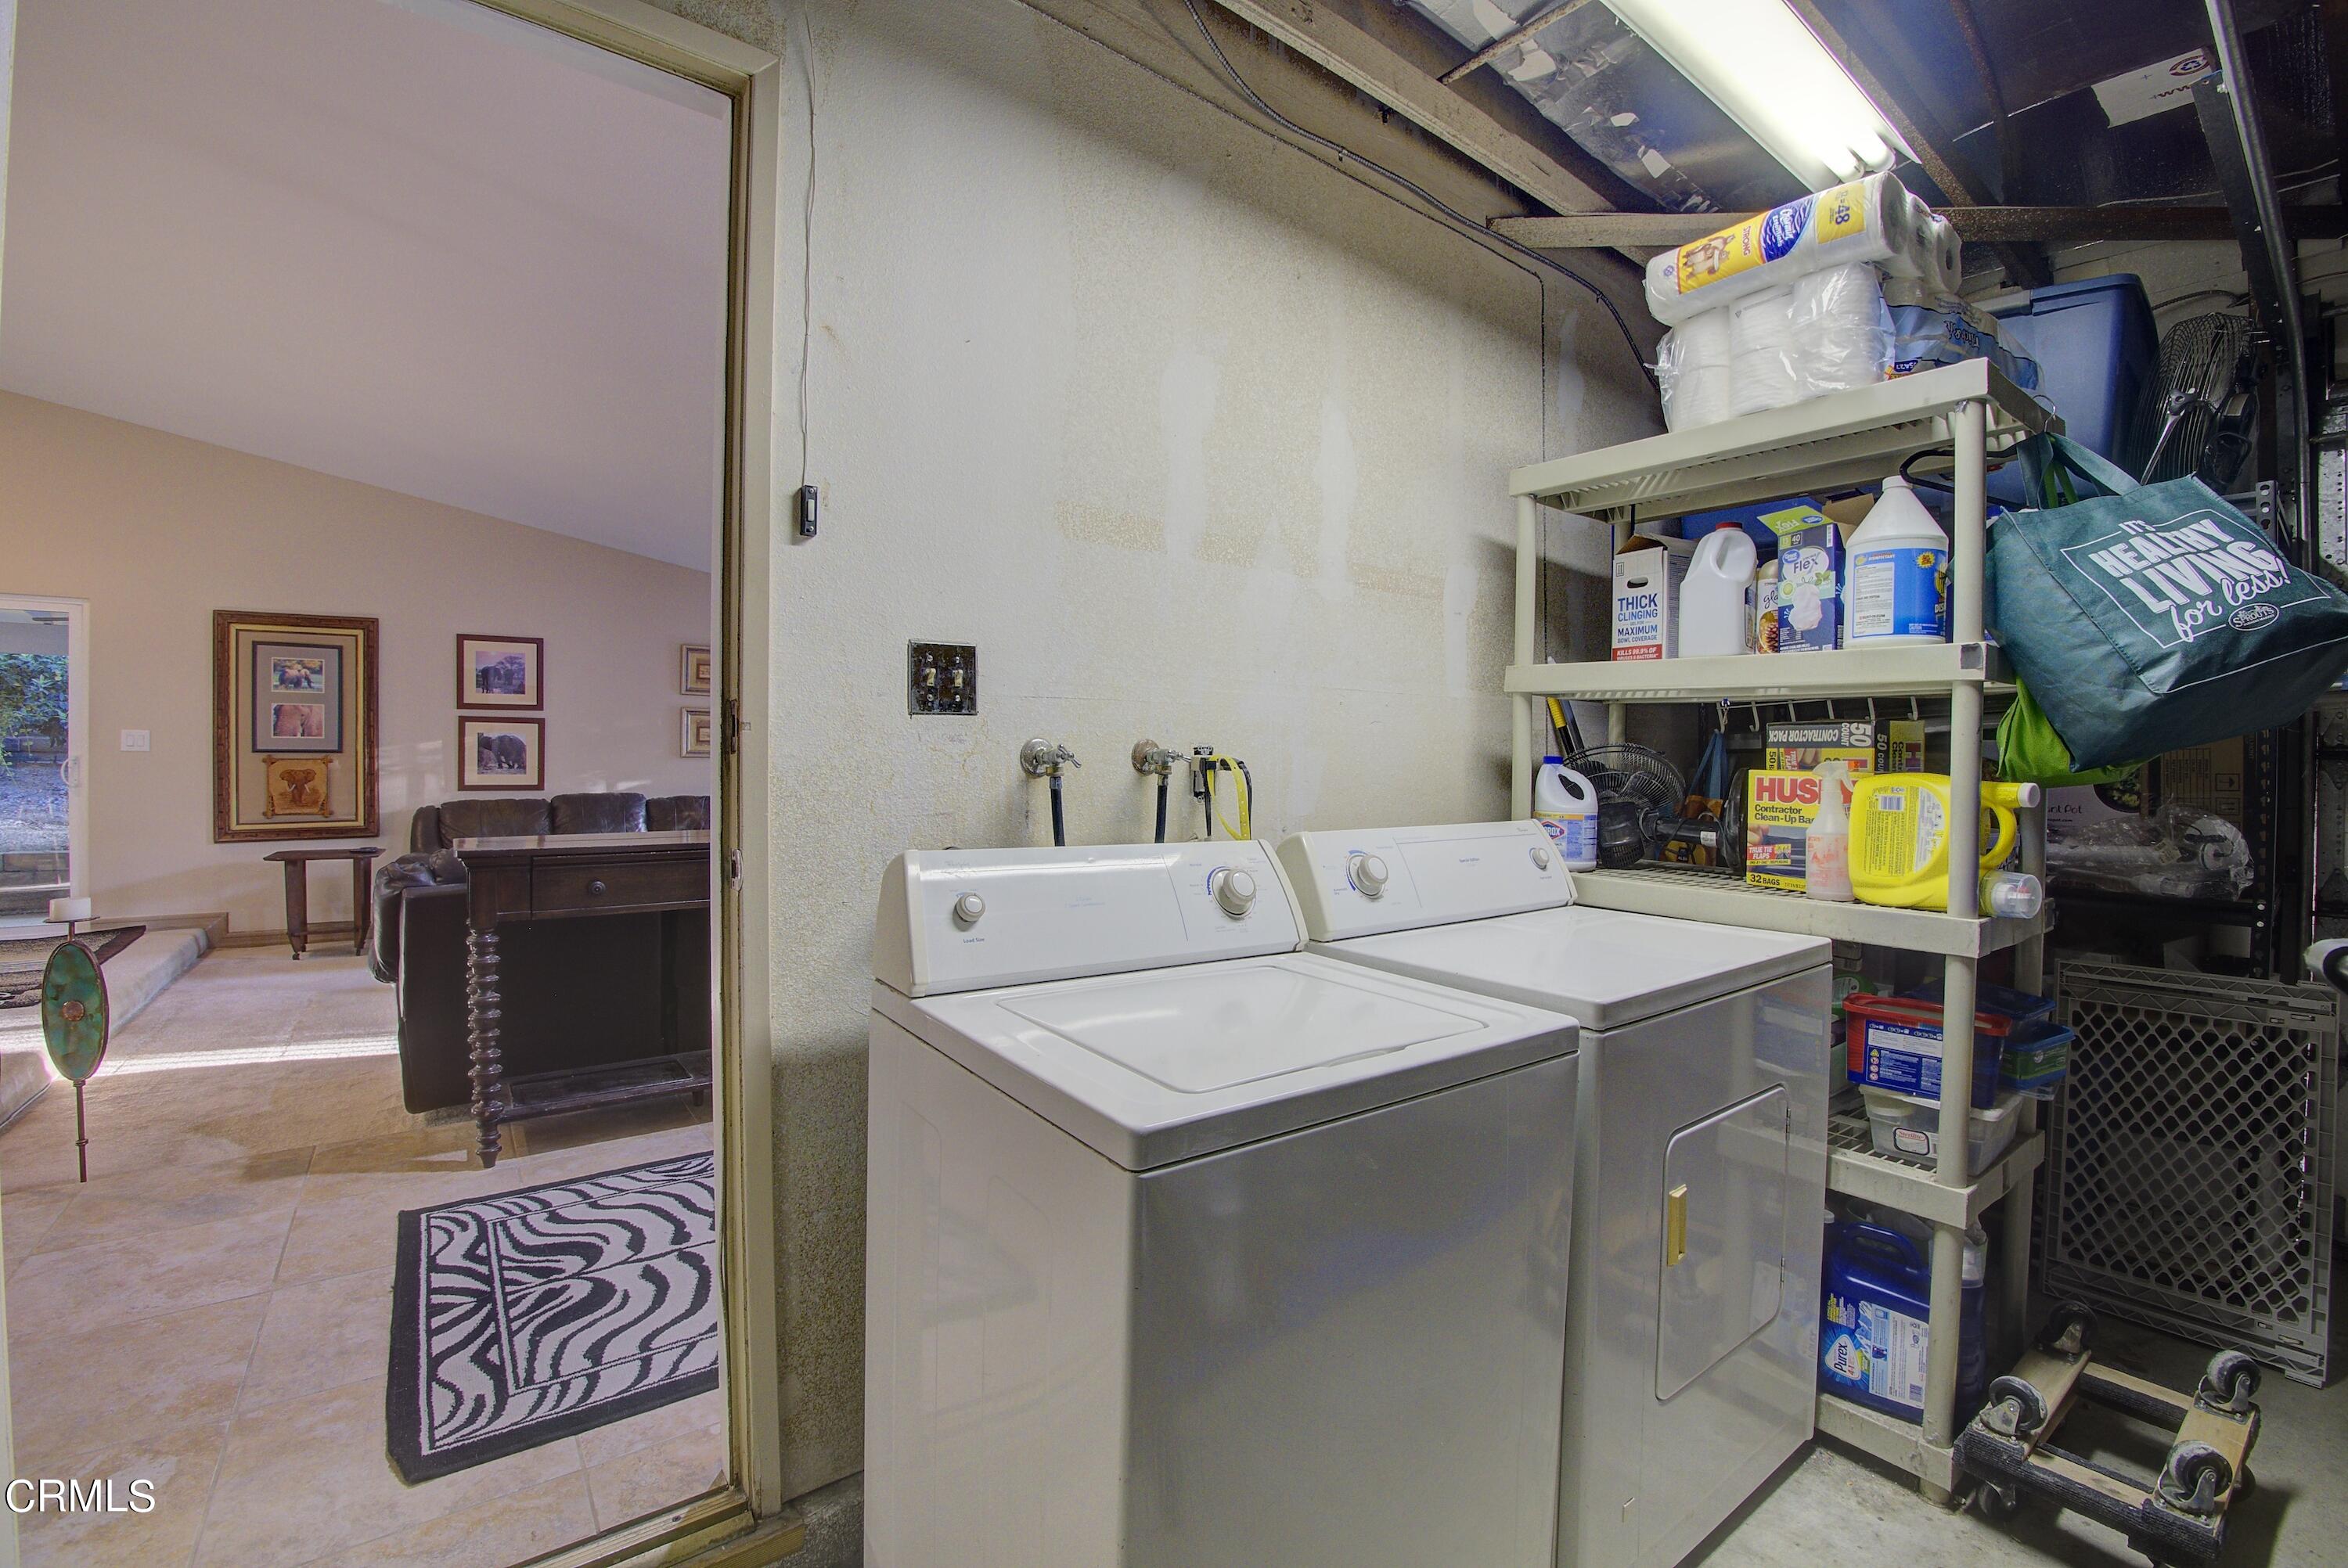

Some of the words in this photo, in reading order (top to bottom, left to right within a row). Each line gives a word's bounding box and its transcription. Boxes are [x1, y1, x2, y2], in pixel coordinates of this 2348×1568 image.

[1835, 205, 1850, 225] 48
[1741, 225, 1752, 257] STRONG
[2118, 520, 2156, 535] IT'S
[2087, 519, 2235, 578] HEALTHY
[1794, 556, 1819, 574] Flex
[2119, 541, 2281, 614] LIVING
[1617, 593, 1658, 612] THICK
[1763, 590, 1778, 609] gla
[2170, 599, 2223, 642] for
[2221, 556, 2292, 606] less!
[1618, 609, 1658, 622] CLINGING
[2233, 607, 2274, 628] SPROUTS
[1618, 624, 1658, 637] MAXIMUM
[1769, 730, 1788, 742] PACK
[1788, 728, 1839, 742] CONTRACTOR
[1841, 722, 1849, 746] COUNT
[1849, 722, 1871, 747] 50
[1877, 732, 1888, 751] 50
[1769, 750, 1777, 764] 50
[1877, 753, 1885, 772] COUN
[1756, 776, 1858, 804] HUSY
[1755, 804, 1802, 815] Contractor
[1755, 813, 1797, 824] Clean-Up
[1799, 815, 1814, 824] Bag
[2064, 804, 2083, 815] Pot
[1544, 826, 1561, 836] ROX
[1750, 873, 1762, 883] 32
[1763, 878, 1781, 886] BAGS
[1834, 1342, 1848, 1373] Purex
